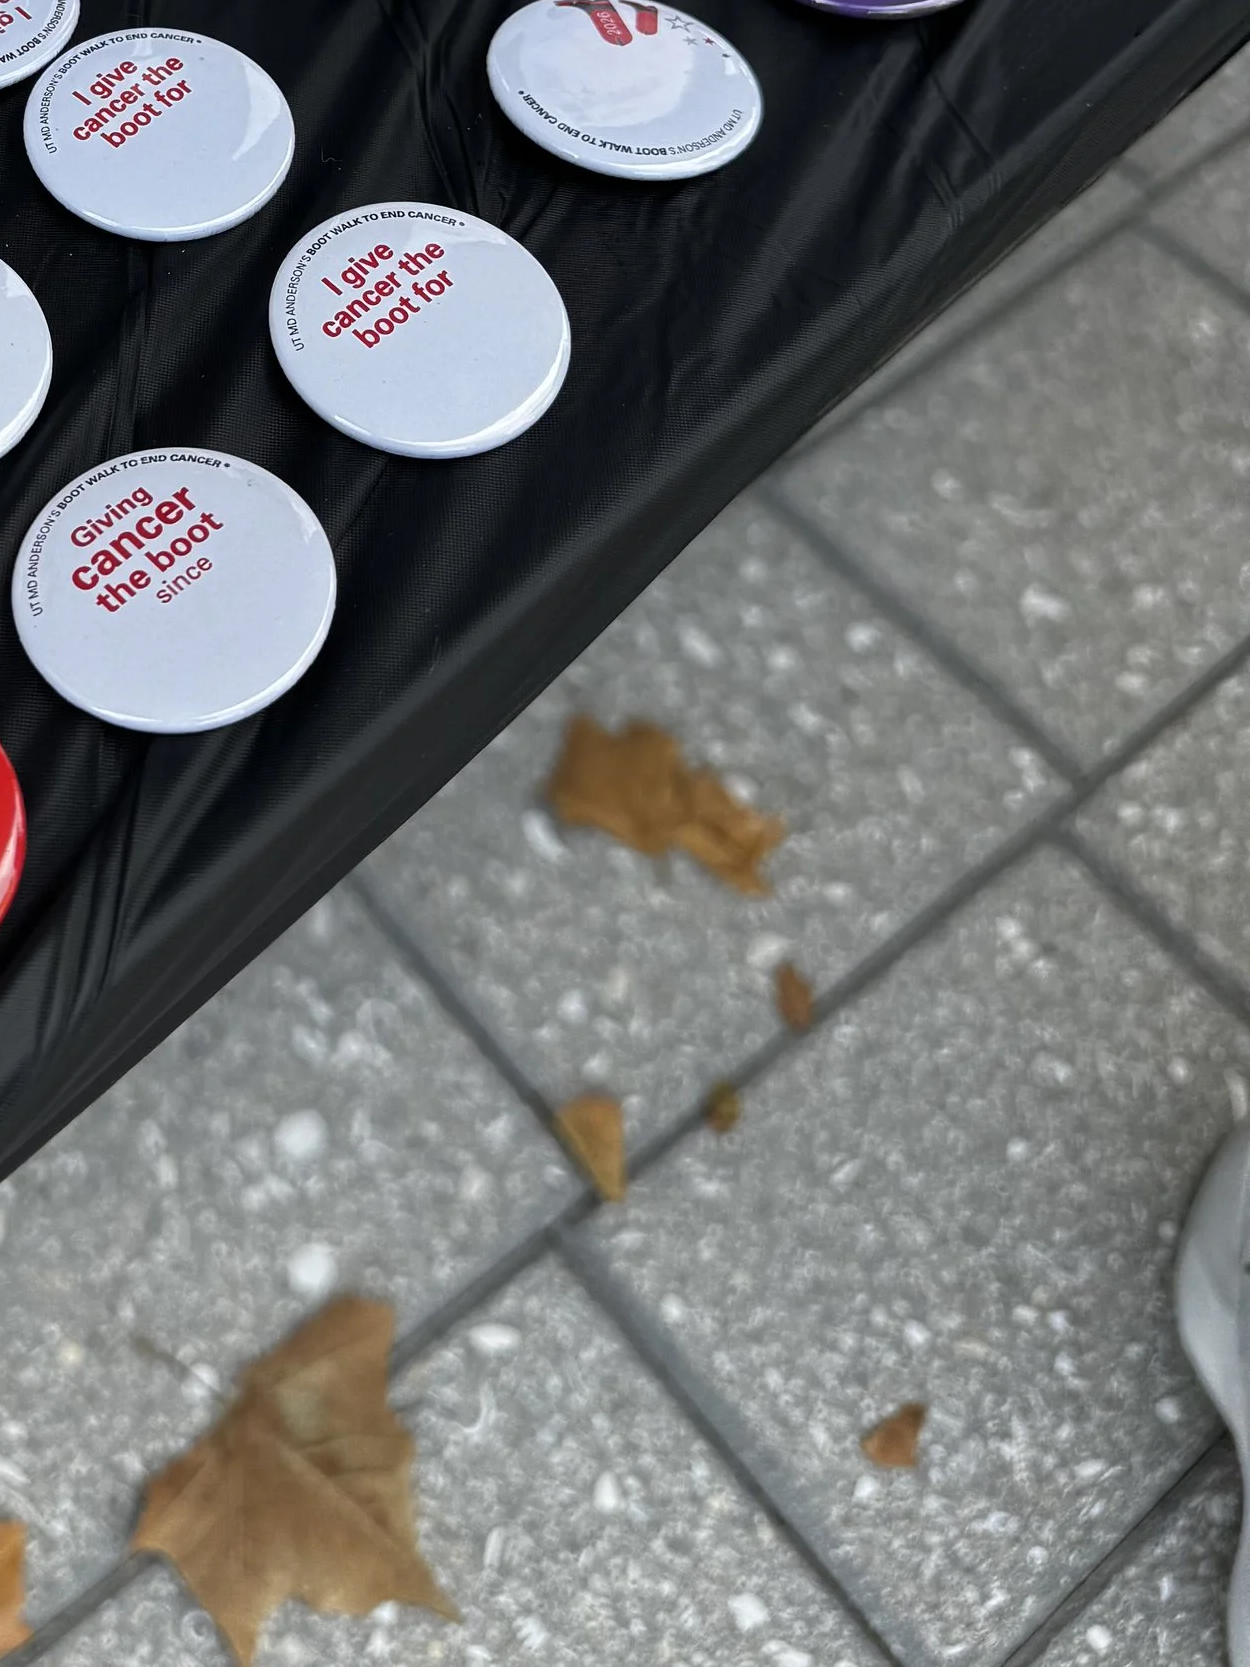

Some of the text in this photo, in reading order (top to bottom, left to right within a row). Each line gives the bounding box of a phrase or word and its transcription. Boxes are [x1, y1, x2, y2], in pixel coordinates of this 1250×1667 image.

[14, 6, 33, 21] I
[597, 11, 620, 35] 2026
[72, 60, 138, 106] I give
[73, 56, 184, 142] cancer the
[100, 80, 193, 149] boot for
[321, 243, 394, 296] I give
[322, 242, 445, 339] cancer the
[352, 268, 454, 349] boot for
[85, 464, 119, 486] WALK
[120, 459, 138, 469] TO
[140, 454, 167, 464] END
[58, 483, 85, 510] BOOT
[70, 486, 154, 548] Giving
[71, 486, 196, 591] cancer
[96, 511, 224, 613] the boot
[28, 580, 38, 601] MD
[156, 555, 213, 604] since
[30, 601, 43, 617] UT
